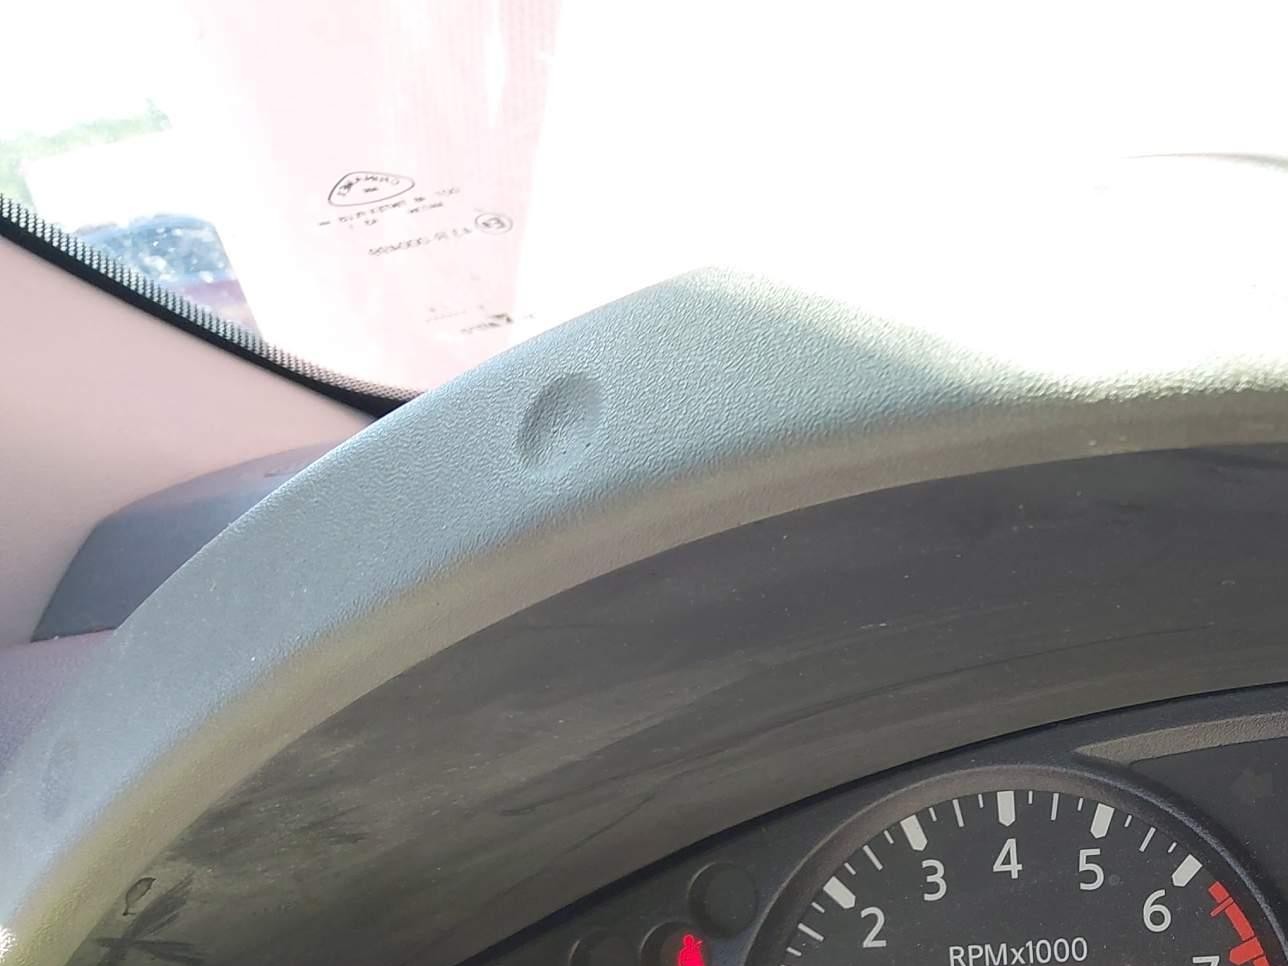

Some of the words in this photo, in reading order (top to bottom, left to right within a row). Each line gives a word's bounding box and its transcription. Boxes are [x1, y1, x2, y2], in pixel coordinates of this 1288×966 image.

[992, 838, 1023, 879] 4
[1078, 848, 1104, 891] 5
[921, 859, 947, 901] 3
[860, 906, 887, 948] 2
[1143, 889, 1172, 932] 6
